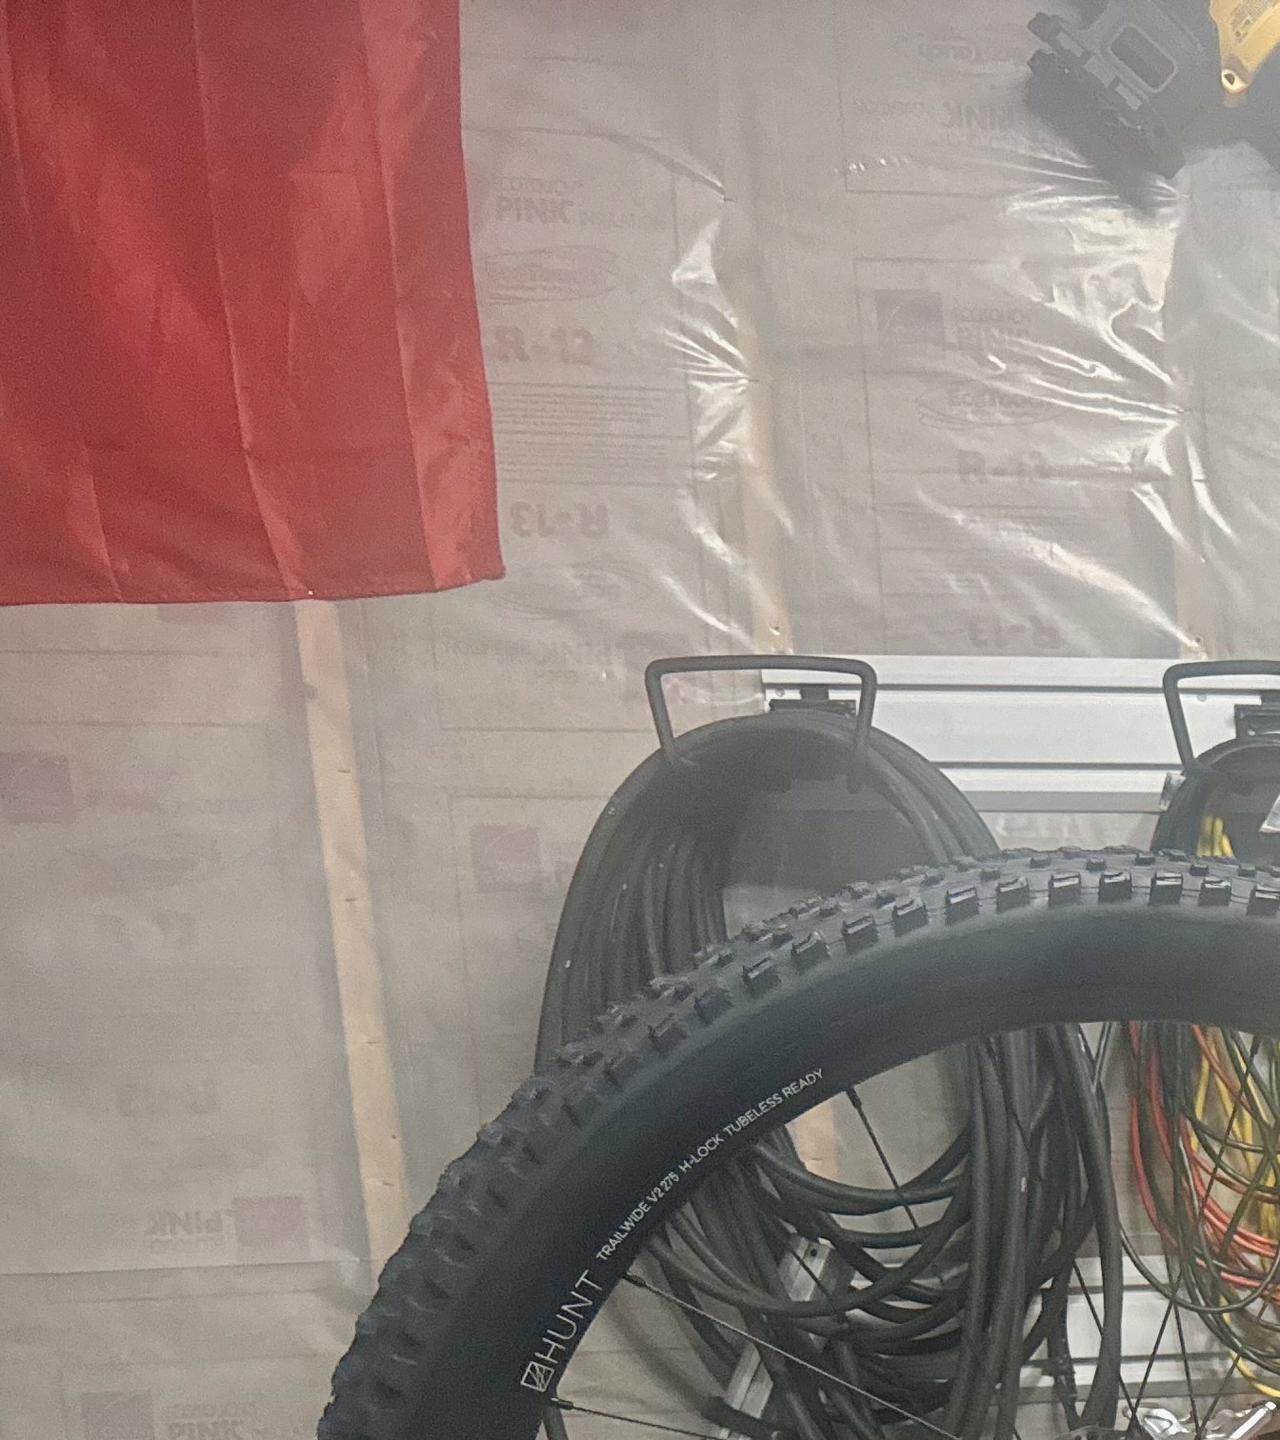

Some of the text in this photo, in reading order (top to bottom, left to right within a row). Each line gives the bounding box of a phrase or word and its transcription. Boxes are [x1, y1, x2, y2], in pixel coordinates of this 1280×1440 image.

[509, 501, 609, 539] R-13
[596, 1068, 824, 1261] TRAILWIDE V2 275 H-LOCK TUBELESS READY
[534, 1269, 603, 1365] HUNT
